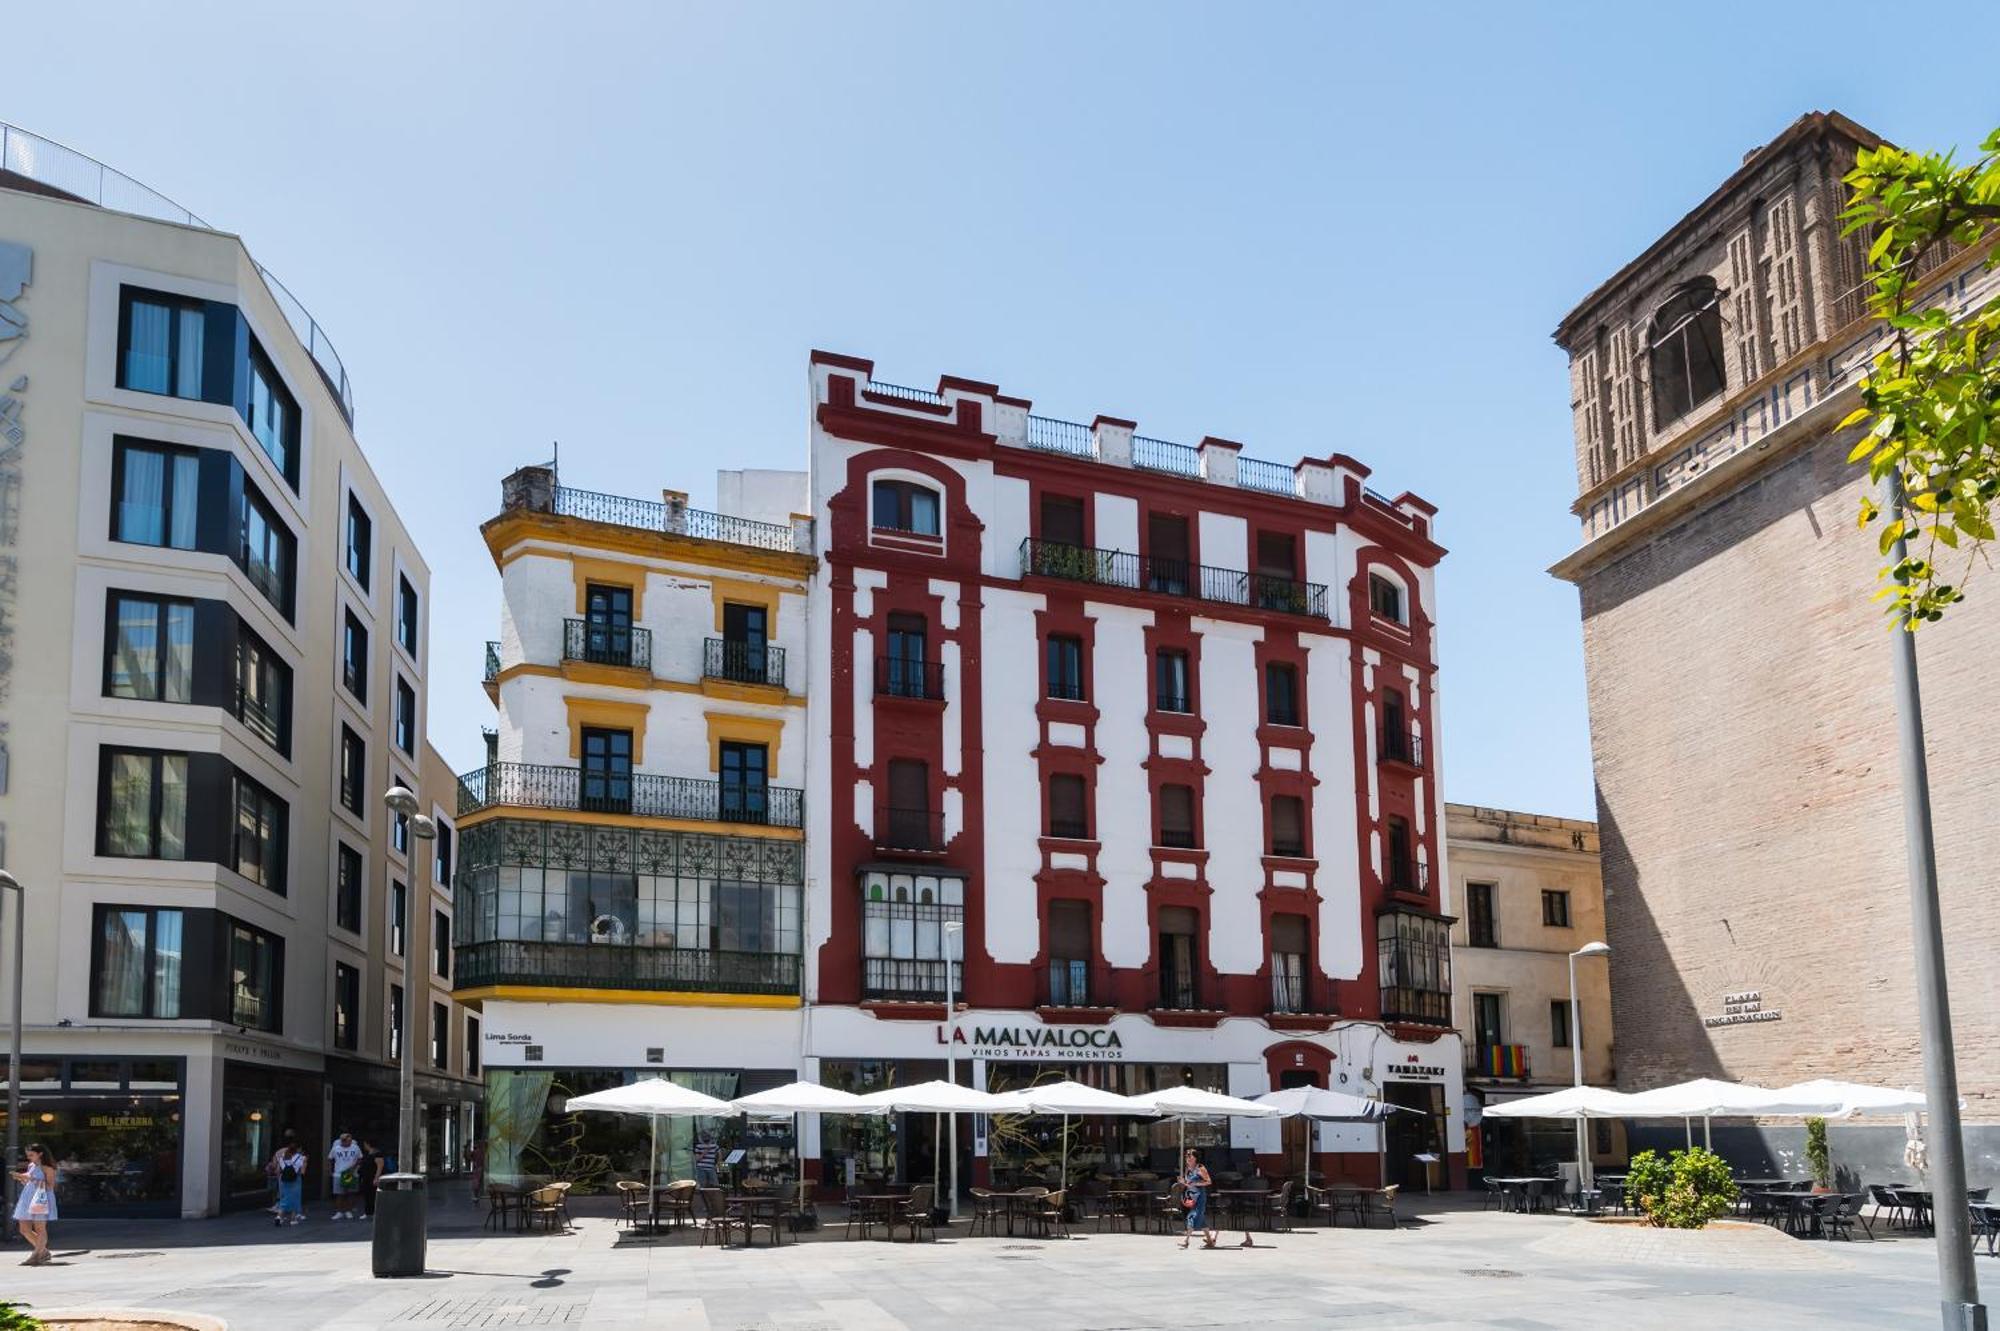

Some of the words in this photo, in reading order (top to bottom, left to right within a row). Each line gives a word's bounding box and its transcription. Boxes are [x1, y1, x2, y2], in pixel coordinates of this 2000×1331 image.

[1725, 993, 1759, 1004] PLAZA
[485, 1033, 506, 1041] Lima
[508, 1033, 532, 1041] Sorda
[937, 1026, 967, 1045] LA
[974, 1027, 1122, 1048] MALVALOCA
[972, 1049, 1009, 1057] VINOS
[1016, 1049, 1050, 1057] TAPAS
[1058, 1050, 1122, 1059] MOMENTOS
